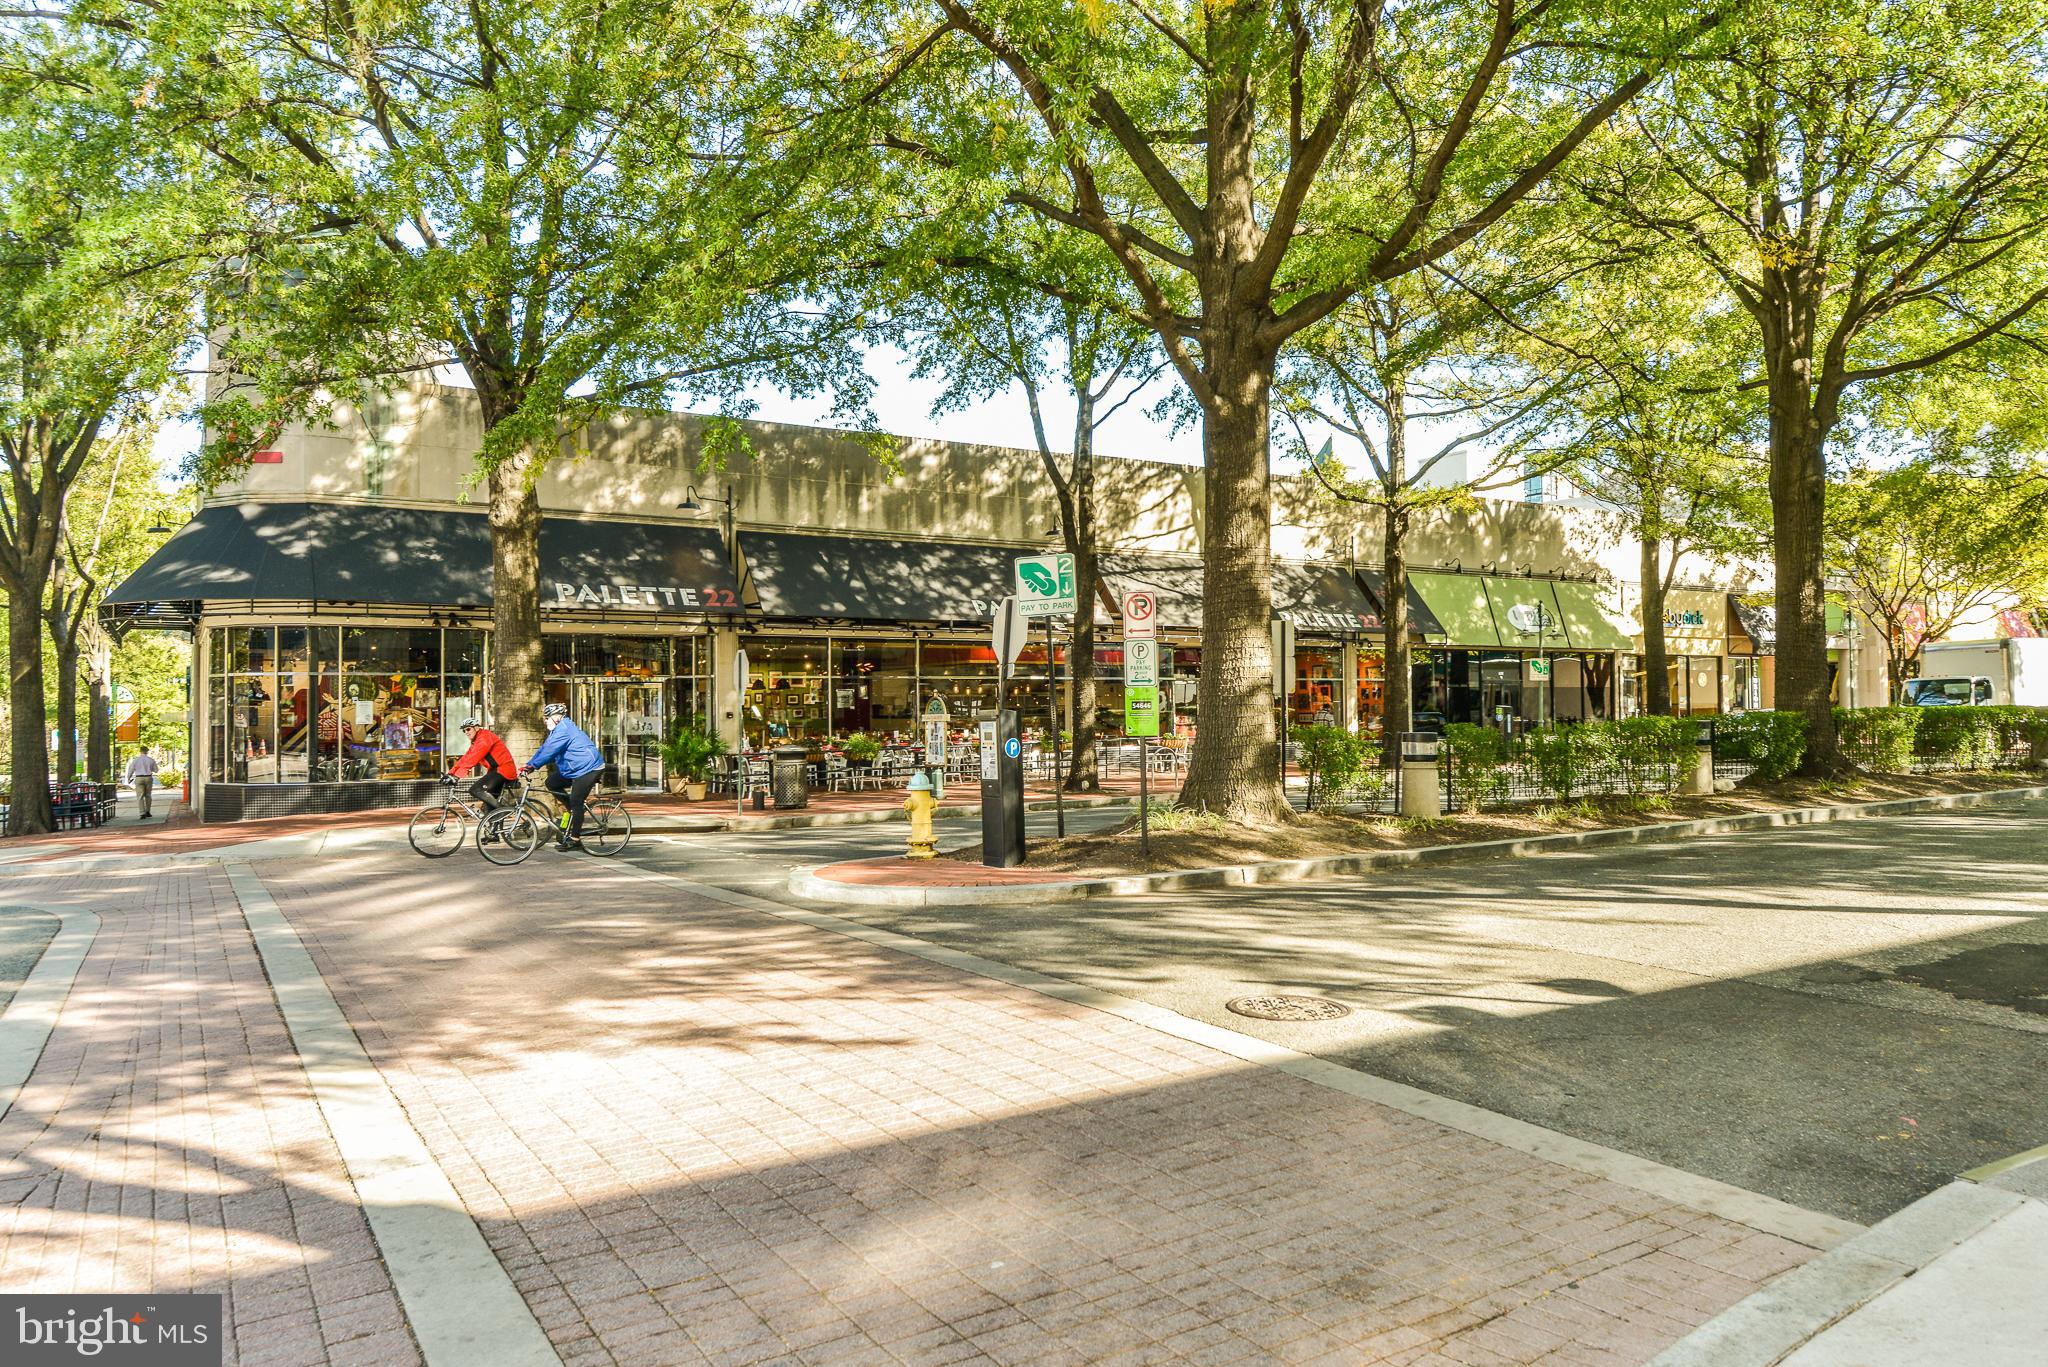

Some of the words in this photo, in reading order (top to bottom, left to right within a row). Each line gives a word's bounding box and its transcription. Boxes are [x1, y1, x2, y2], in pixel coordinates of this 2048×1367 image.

[1059, 557, 1073, 574] 2
[555, 583, 700, 607] PALETTE
[703, 588, 737, 607] 22
[1020, 604, 1036, 612] PAY
[1039, 603, 1050, 611] TO
[1052, 601, 1073, 610] PARK
[1278, 611, 1362, 628] PALETTE
[1357, 613, 1382, 628] 22
[1137, 645, 1145, 657] P
[1010, 744, 1017, 755] P
